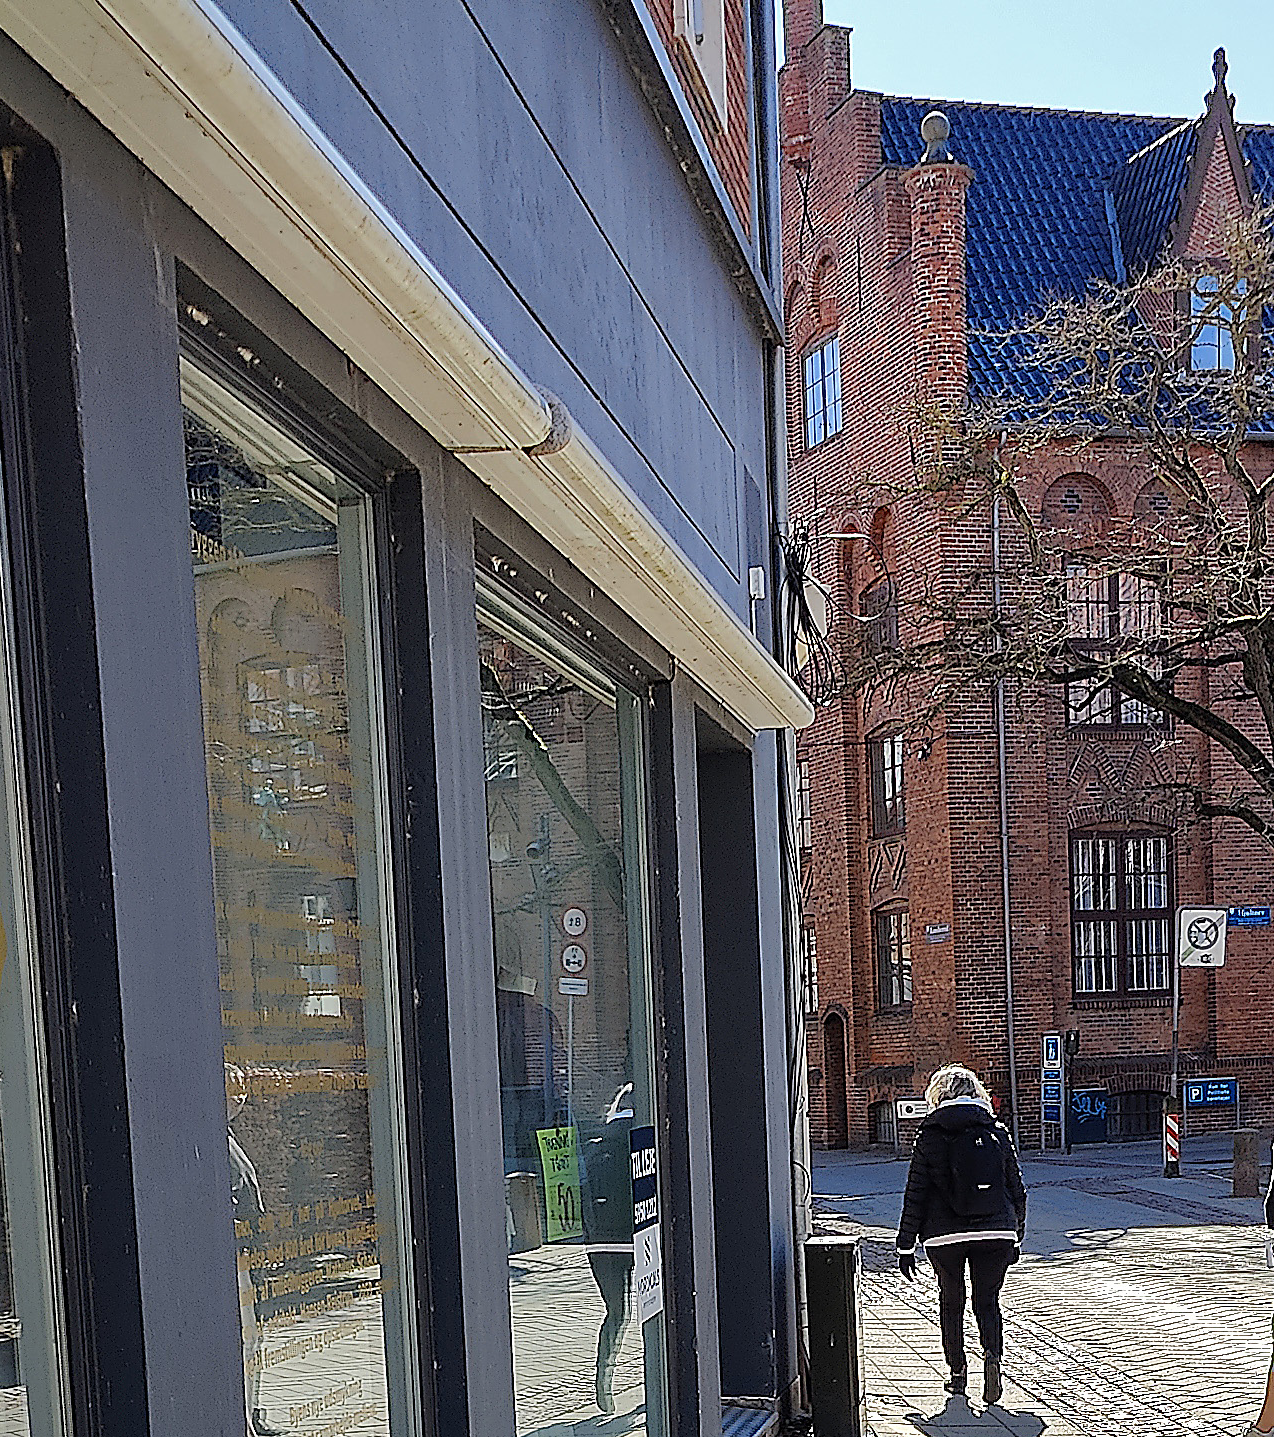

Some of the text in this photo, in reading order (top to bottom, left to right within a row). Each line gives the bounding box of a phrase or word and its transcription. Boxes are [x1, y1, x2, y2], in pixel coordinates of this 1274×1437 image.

[1192, 1088, 1199, 1100] P
[631, 1147, 656, 1180] TIL LEJE
